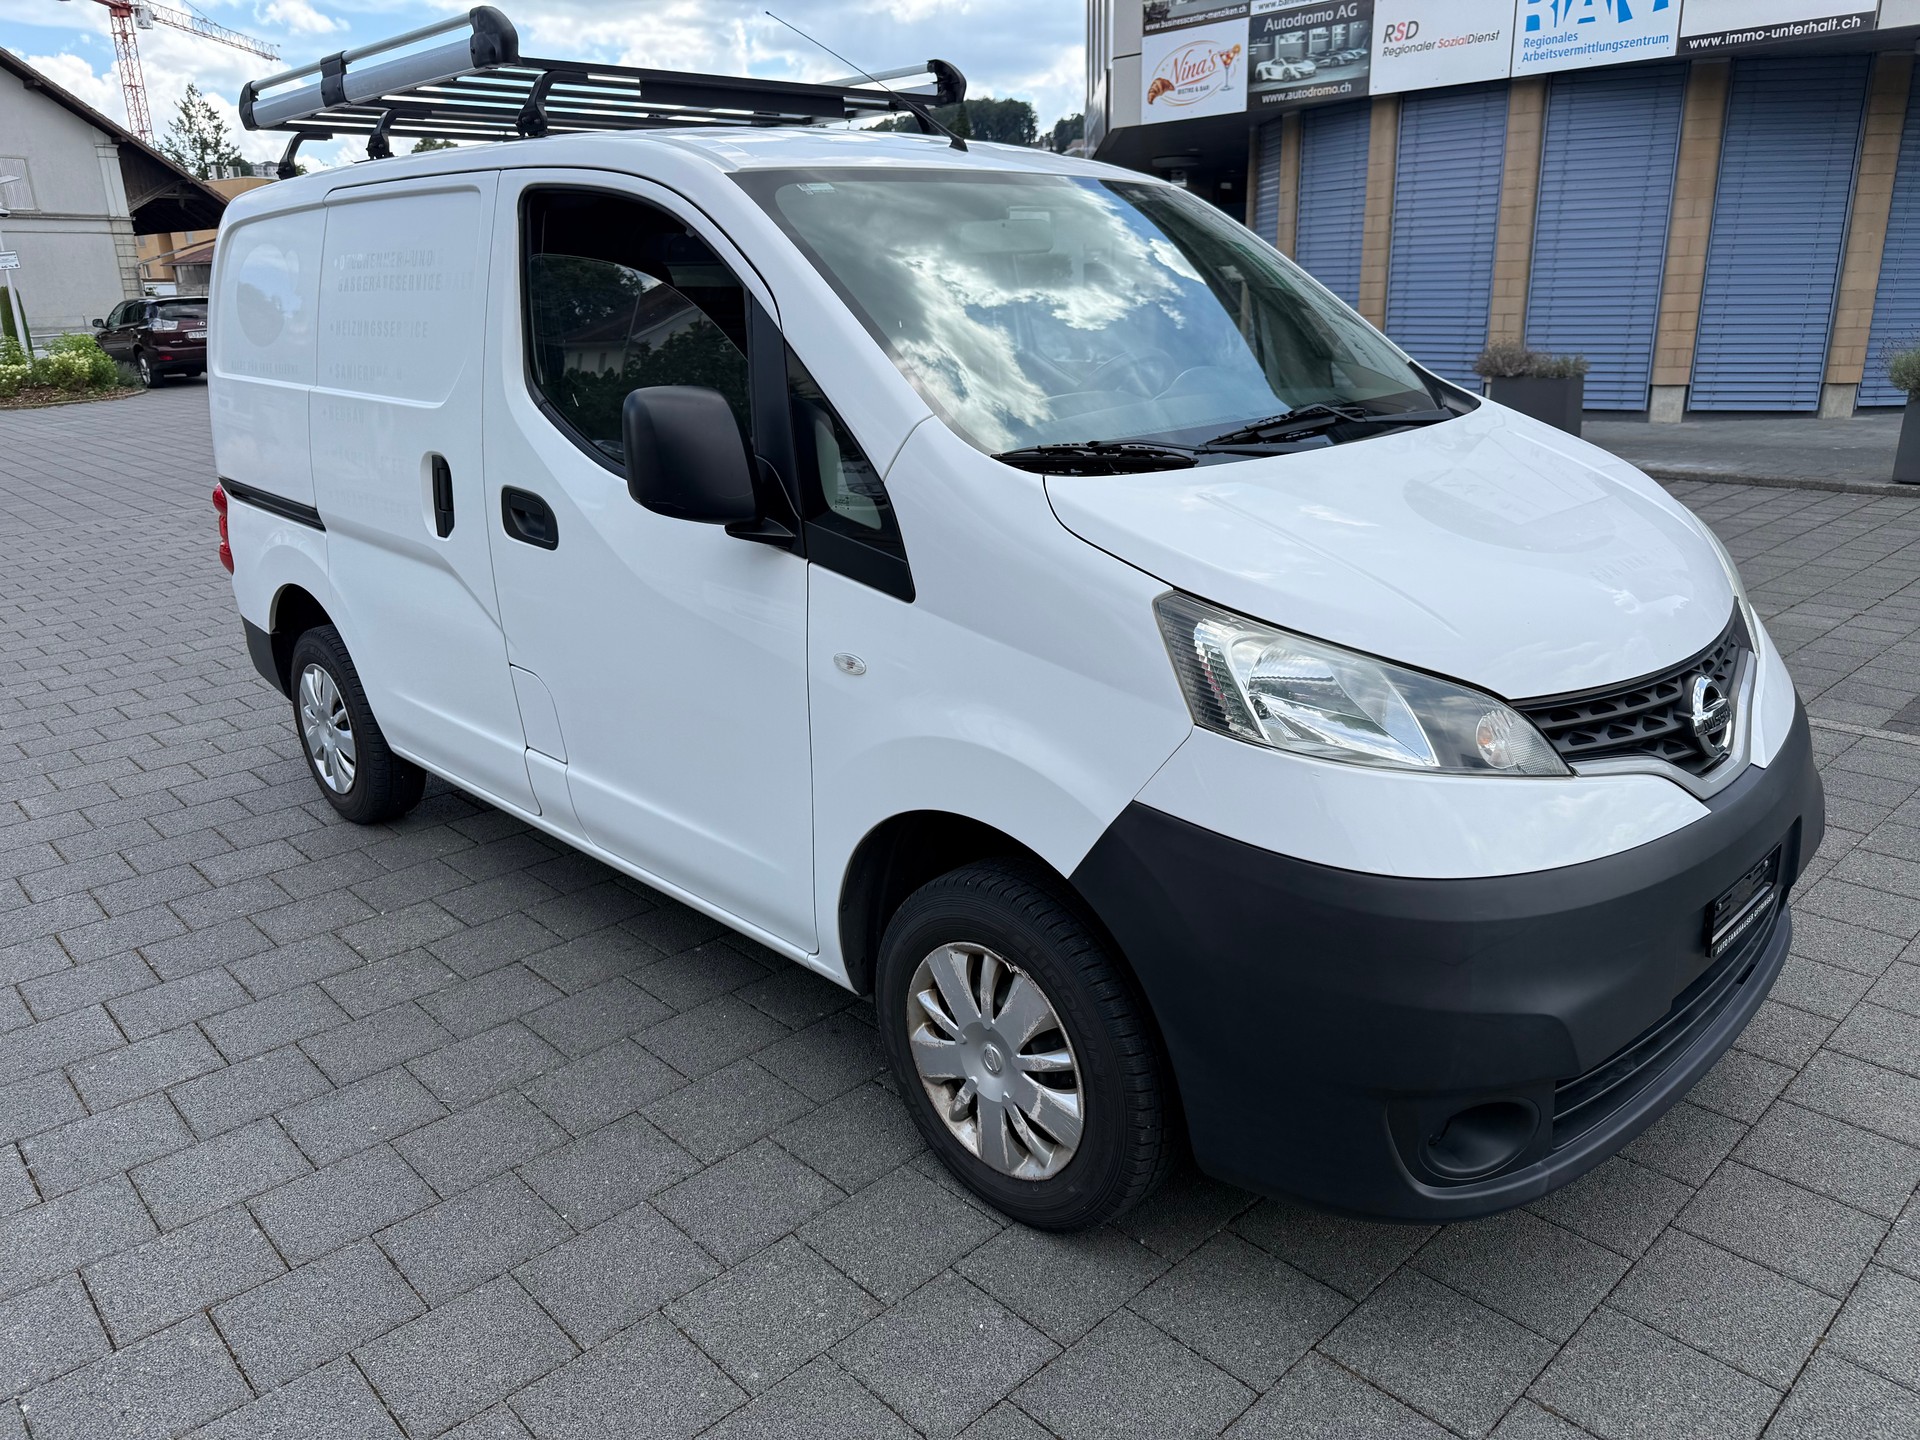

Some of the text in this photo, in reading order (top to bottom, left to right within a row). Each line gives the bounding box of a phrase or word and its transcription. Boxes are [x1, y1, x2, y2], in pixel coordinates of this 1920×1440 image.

[1263, 3, 1358, 32] Autodromo AG
[1382, 29, 1500, 58] Regionaler SozialDienst
[1383, 20, 1419, 44] RSD
[1523, 32, 1578, 49] Regionales
[1689, 16, 1861, 49] www.immo-unterhalt.ch
[1522, 34, 1669, 62] Arbeitsvermittlungszentrum
[1171, 49, 1218, 84] Nina's
[1262, 82, 1352, 104] www.autodromo.ch
[335, 319, 428, 339] HEIZUNGSSERICE
[1716, 938, 1728, 955] AUTO
